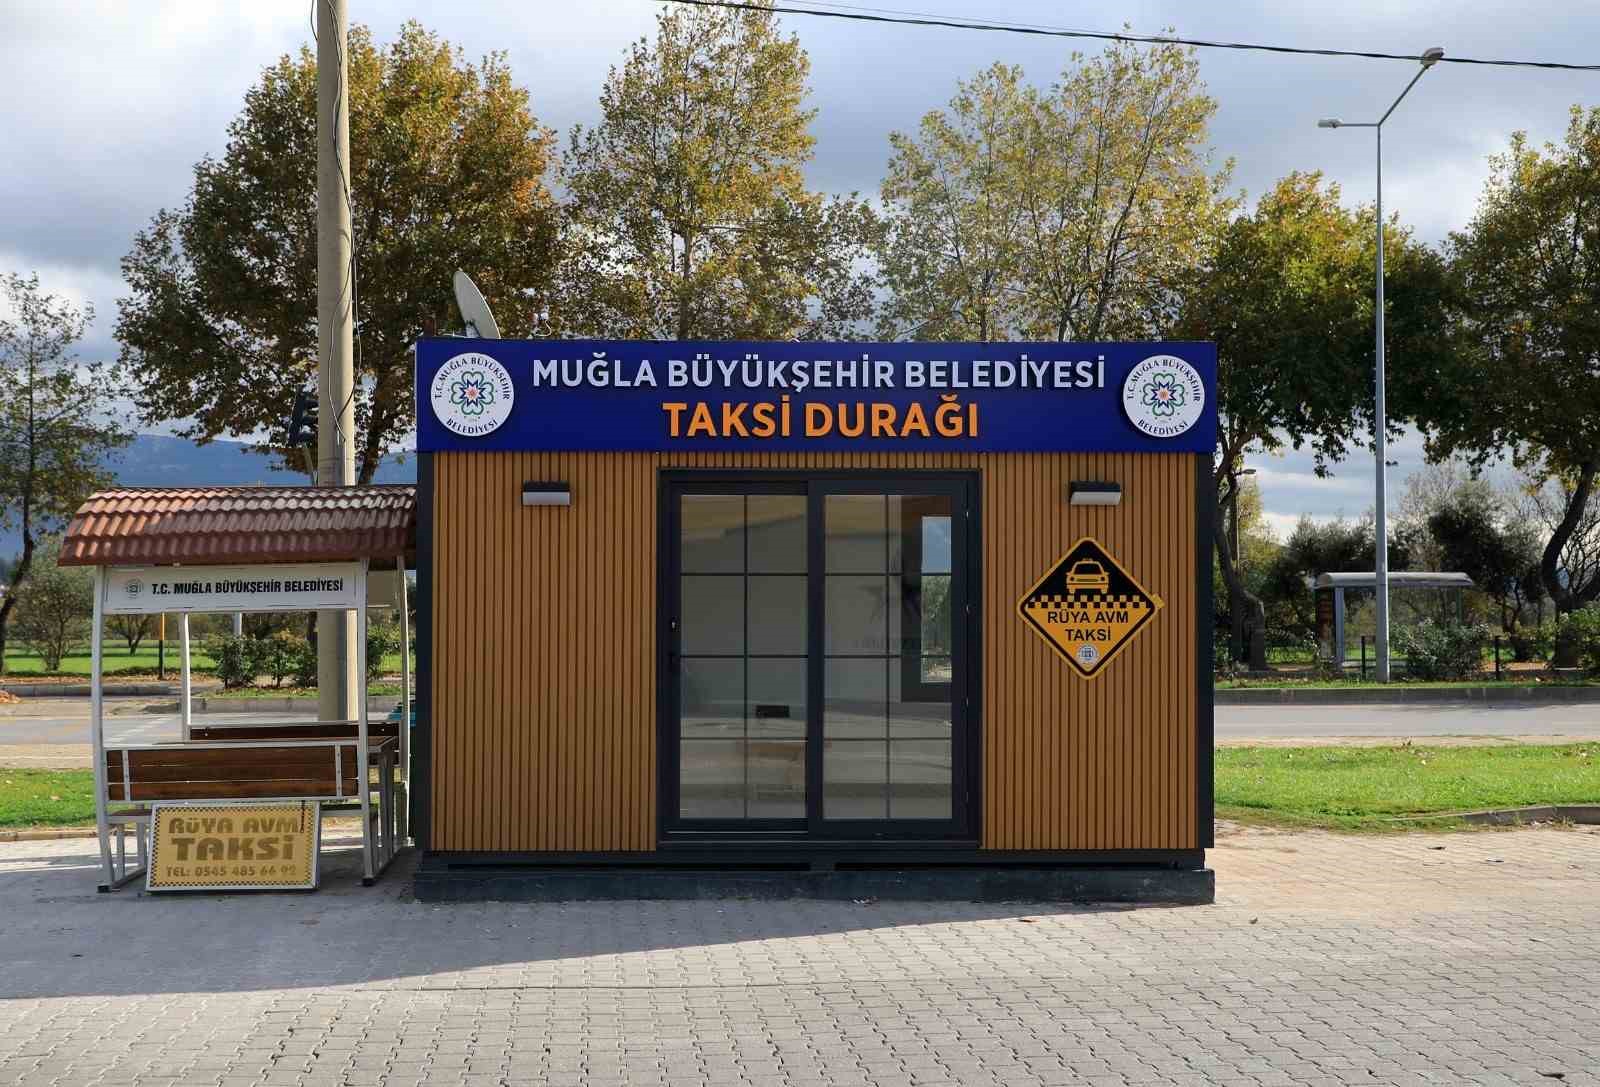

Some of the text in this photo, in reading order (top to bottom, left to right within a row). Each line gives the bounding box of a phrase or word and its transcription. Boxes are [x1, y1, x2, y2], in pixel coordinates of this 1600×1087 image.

[534, 352, 1106, 393] MUĞLA BÜYÜKŞEHİR BELEDİYESİ
[662, 393, 978, 438] TAKSİ DURAĞI
[151, 583, 171, 595] T.C.
[174, 580, 212, 594] MUĞLA
[216, 578, 281, 595] BÜYÜKŞEHİR
[284, 577, 344, 593] BELEDİYESİ
[1047, 608, 1129, 624] RÜYA AVM
[1065, 626, 1111, 641] TAKSİ
[169, 818, 299, 834] RÜYA AVM
